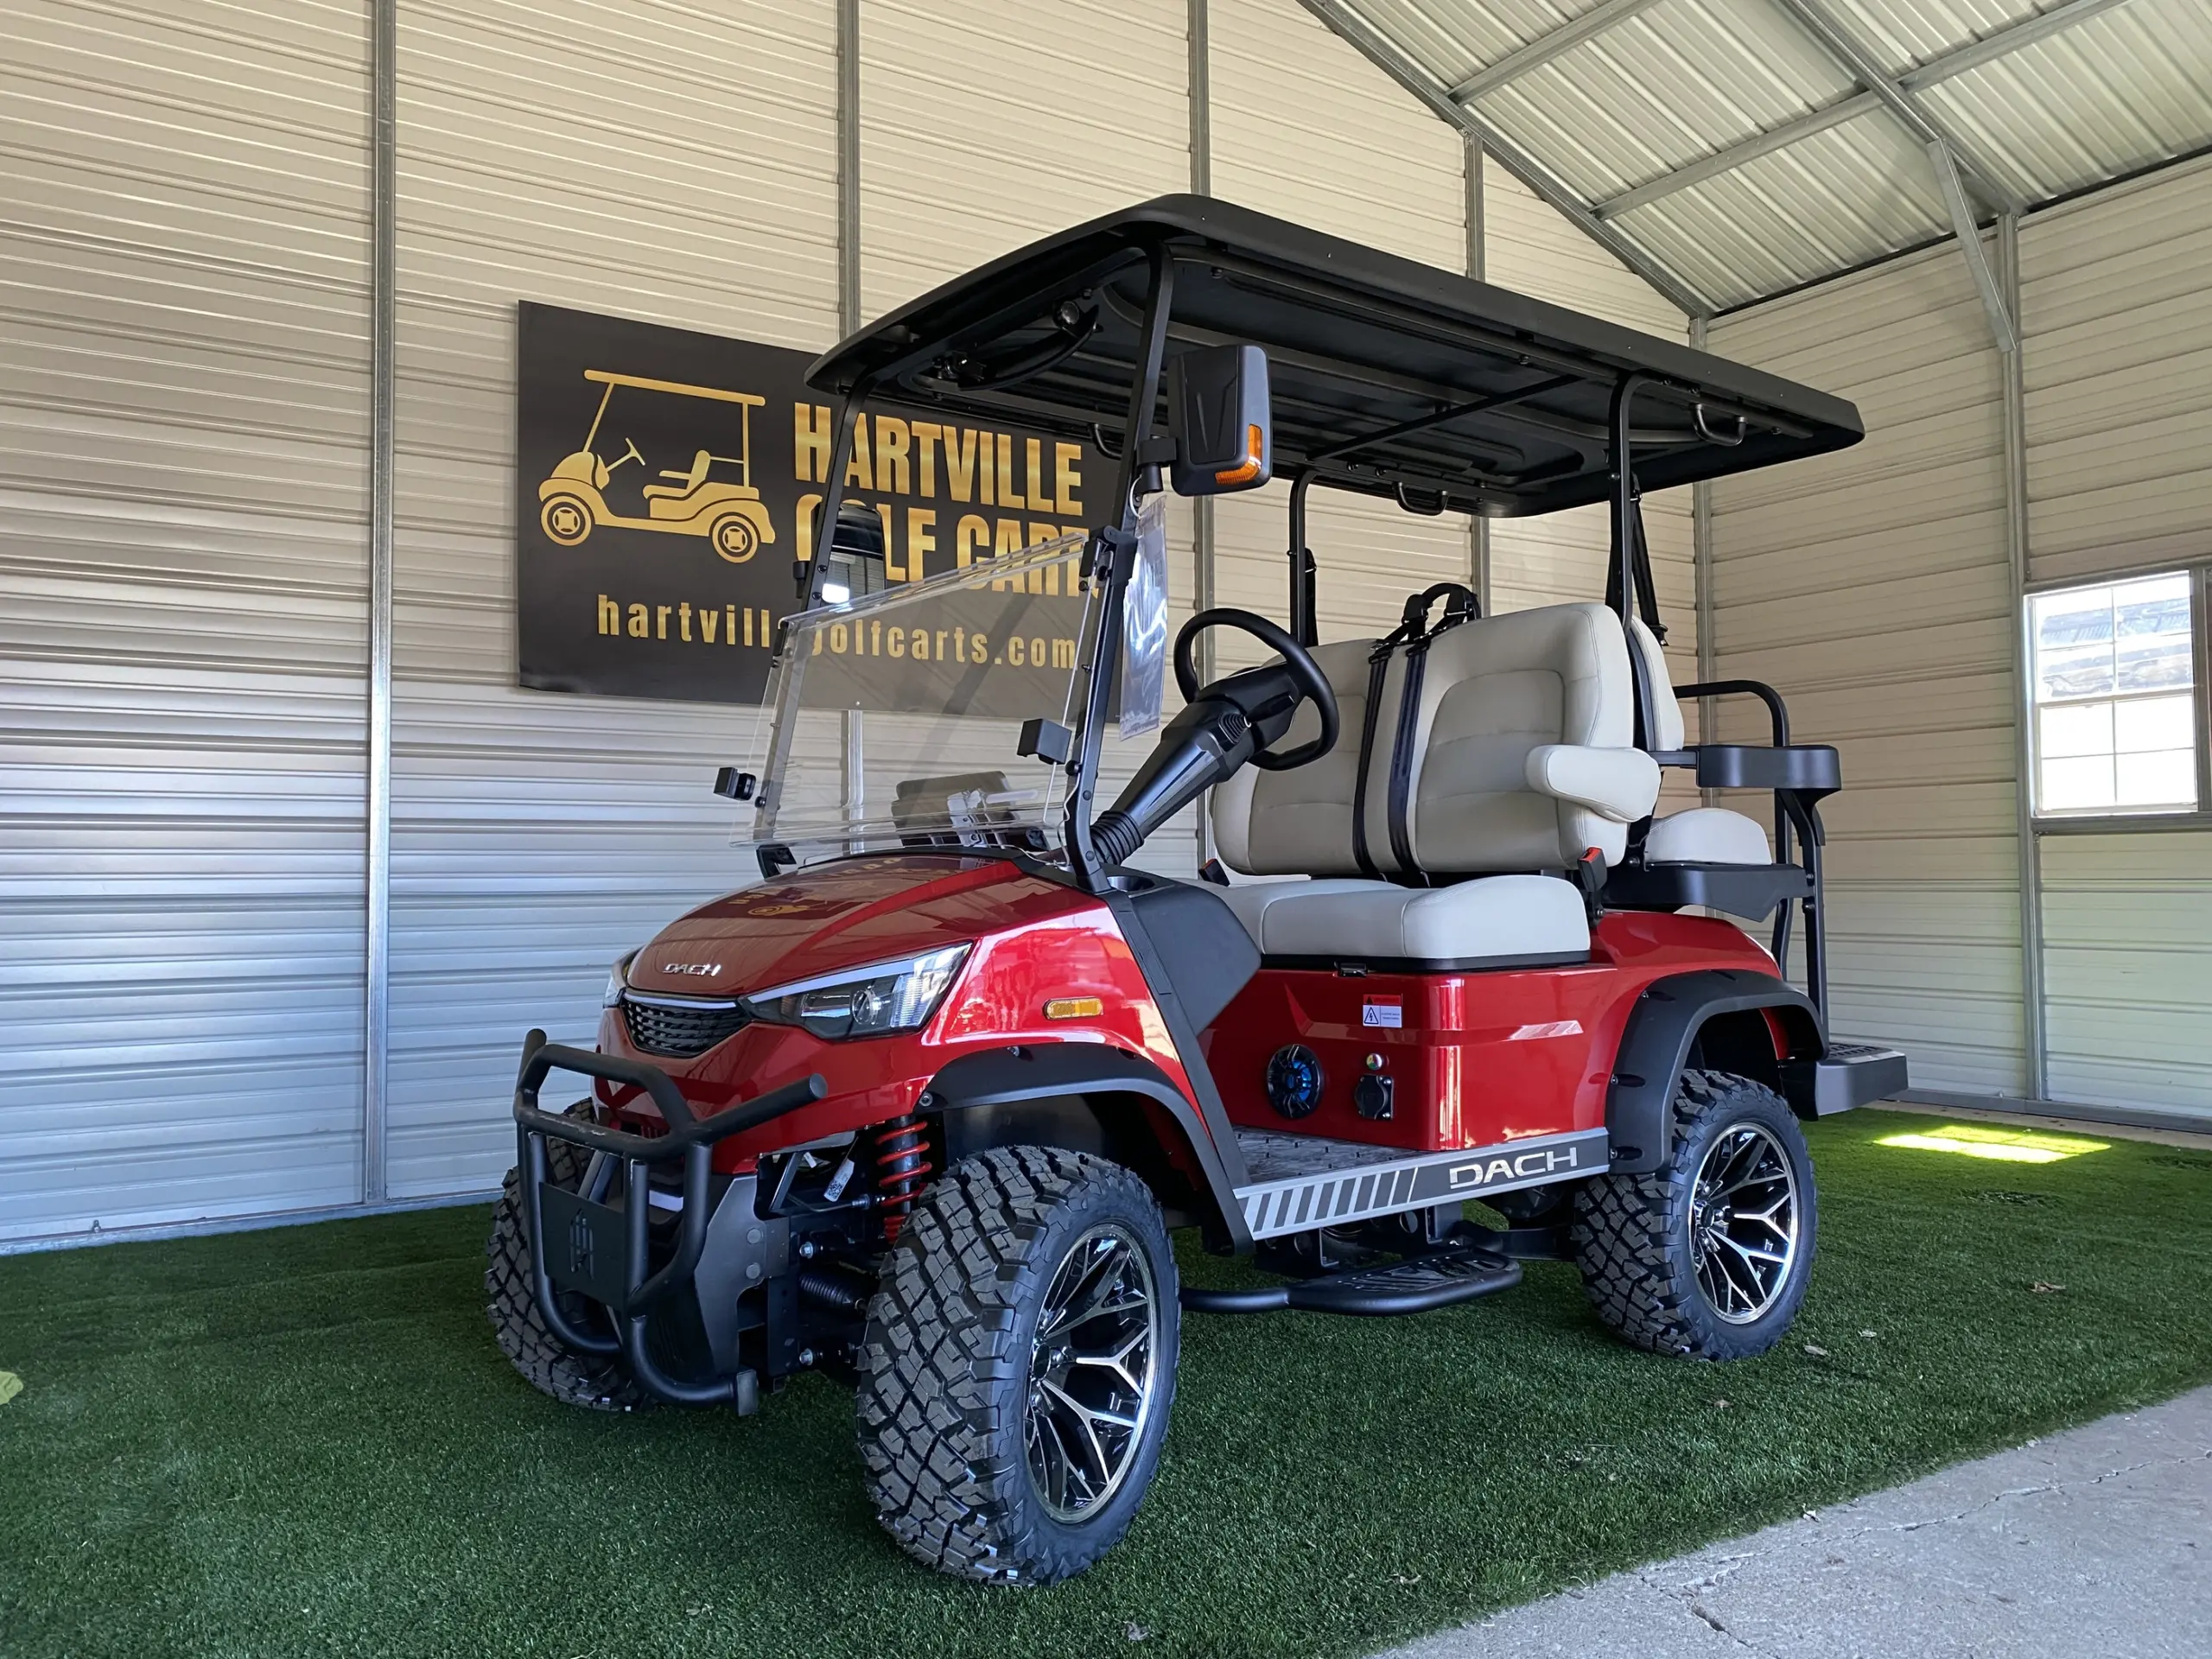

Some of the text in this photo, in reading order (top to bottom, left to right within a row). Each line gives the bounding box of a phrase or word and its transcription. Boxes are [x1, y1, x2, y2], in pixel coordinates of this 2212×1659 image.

[794, 401, 1083, 517] HARTVILLE
[956, 513, 1099, 599] CART
[597, 594, 1077, 671] hartvillolfcarts.com
[663, 963, 721, 977] DACH
[1449, 1147, 1577, 1190] DACH
